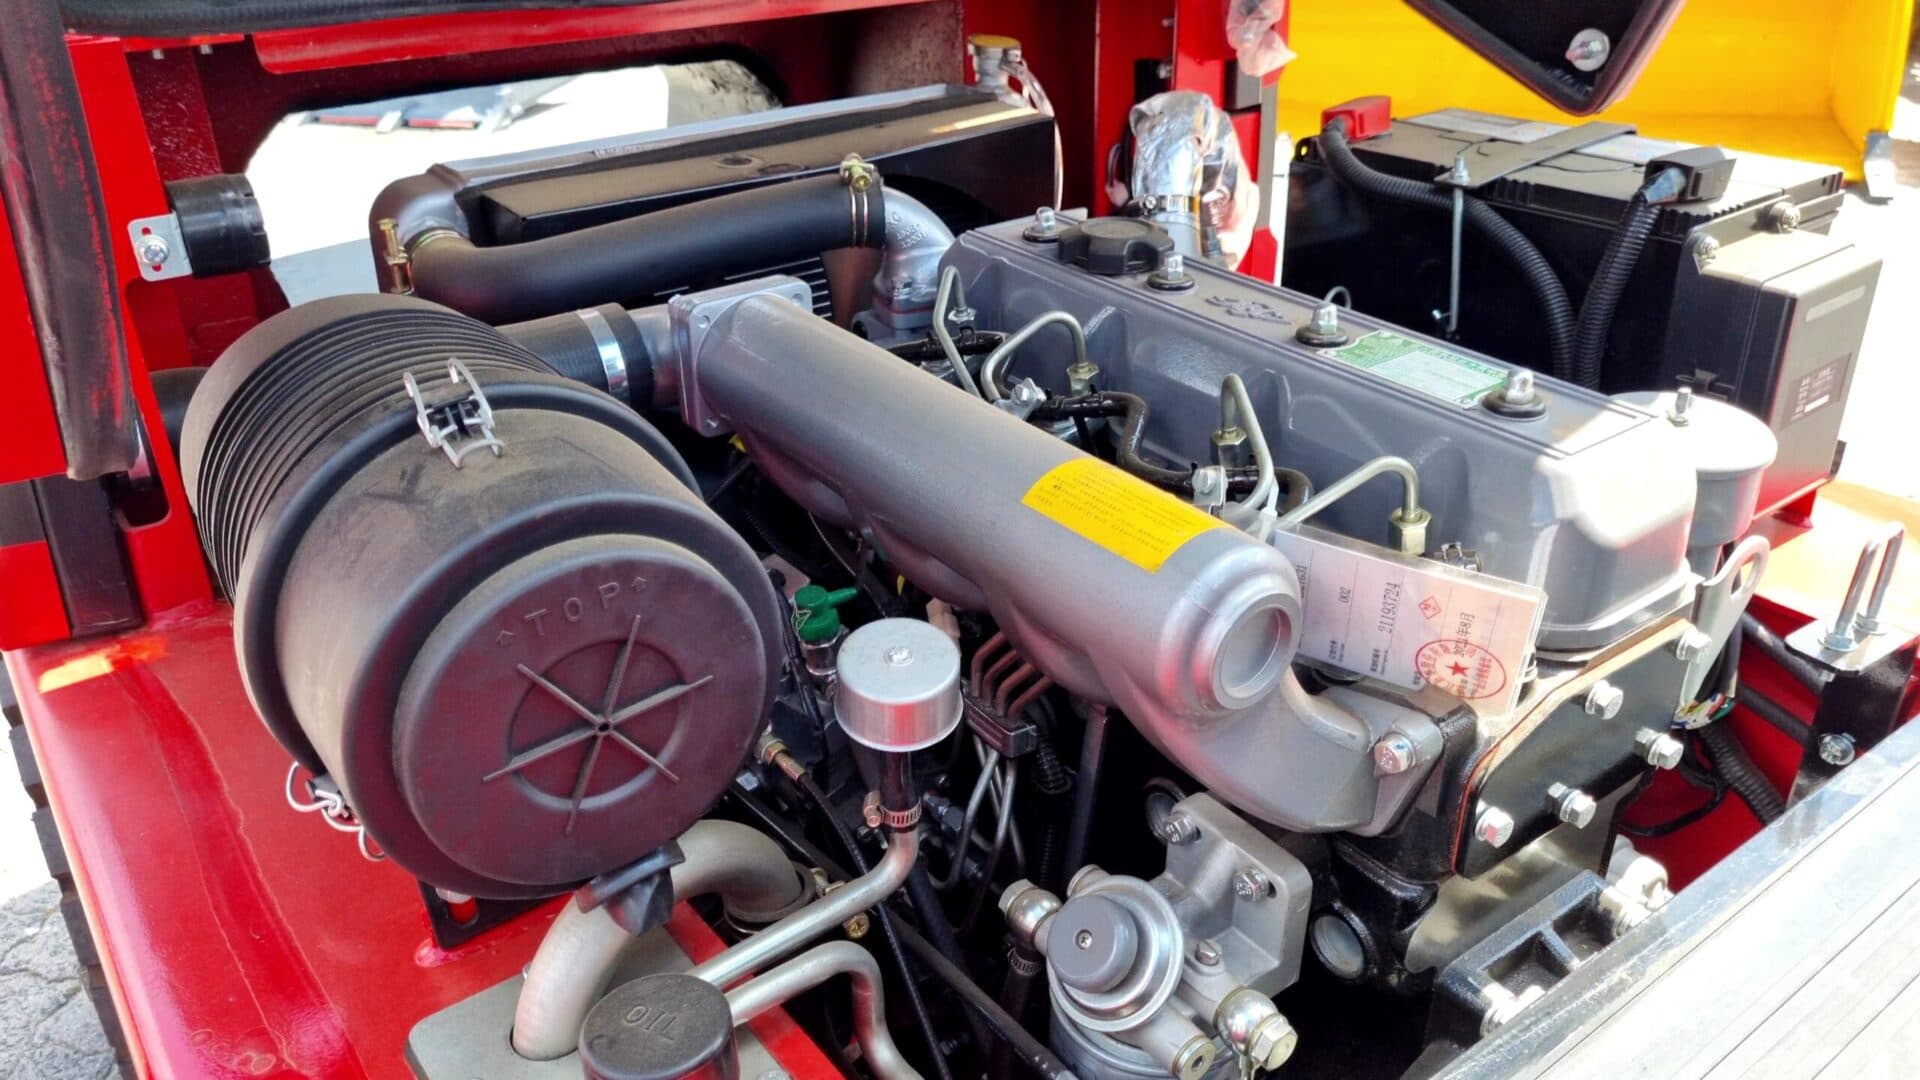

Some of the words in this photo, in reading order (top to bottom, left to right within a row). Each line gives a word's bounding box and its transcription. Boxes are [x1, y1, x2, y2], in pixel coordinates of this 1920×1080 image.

[524, 581, 621, 637] TOP
[1377, 581, 1401, 634] 21193724
[623, 1004, 678, 1041] OIL
